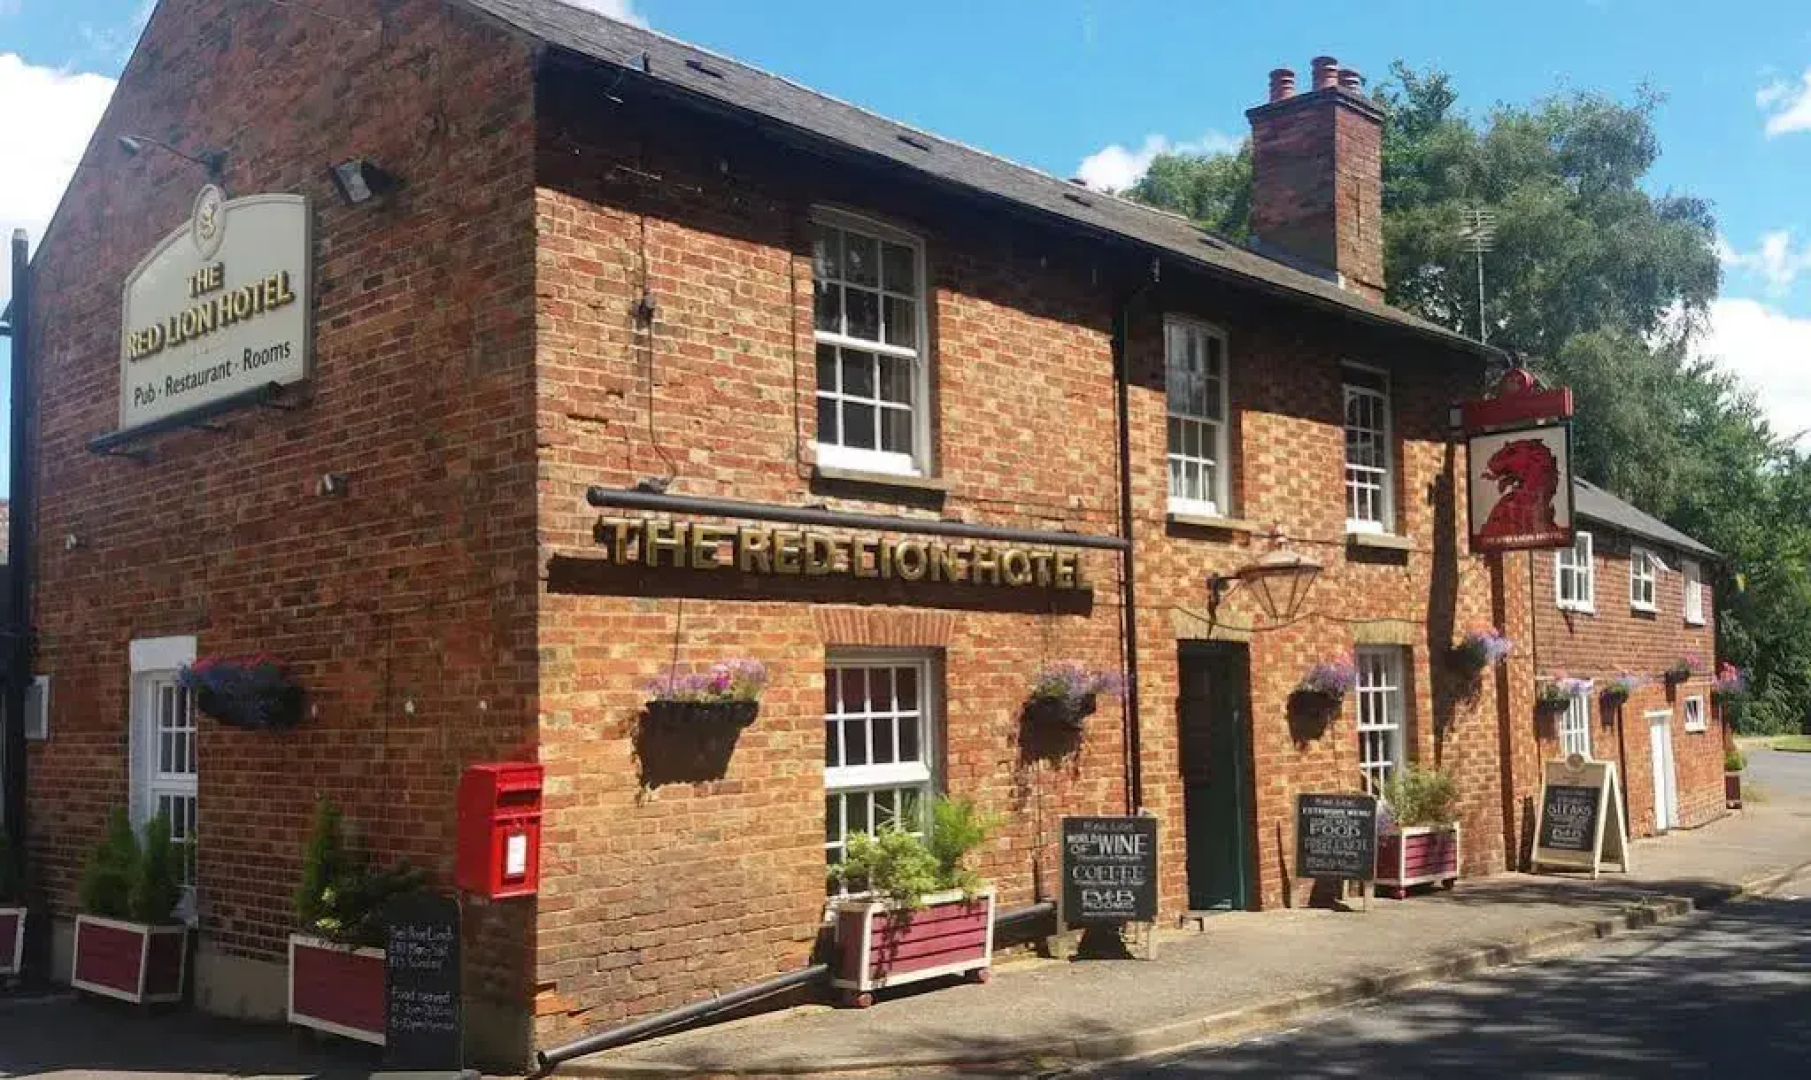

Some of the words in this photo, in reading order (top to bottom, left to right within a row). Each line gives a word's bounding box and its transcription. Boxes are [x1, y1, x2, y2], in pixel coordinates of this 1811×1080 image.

[188, 262, 224, 298] THE
[127, 323, 164, 362] RED
[167, 300, 217, 347] LION
[218, 270, 294, 327] HOTEL
[133, 386, 156, 407] Pub
[166, 360, 232, 397] Restaurant
[243, 341, 290, 372] Rooms
[599, 515, 738, 571] THE
[740, 525, 838, 576] RED
[853, 536, 962, 583] LION
[971, 545, 1093, 592] HOTEL
[1099, 833, 1148, 855] WINE
[1310, 823, 1361, 837] FOOD
[1071, 843, 1092, 854] OF
[1073, 865, 1146, 880] COFFEE
